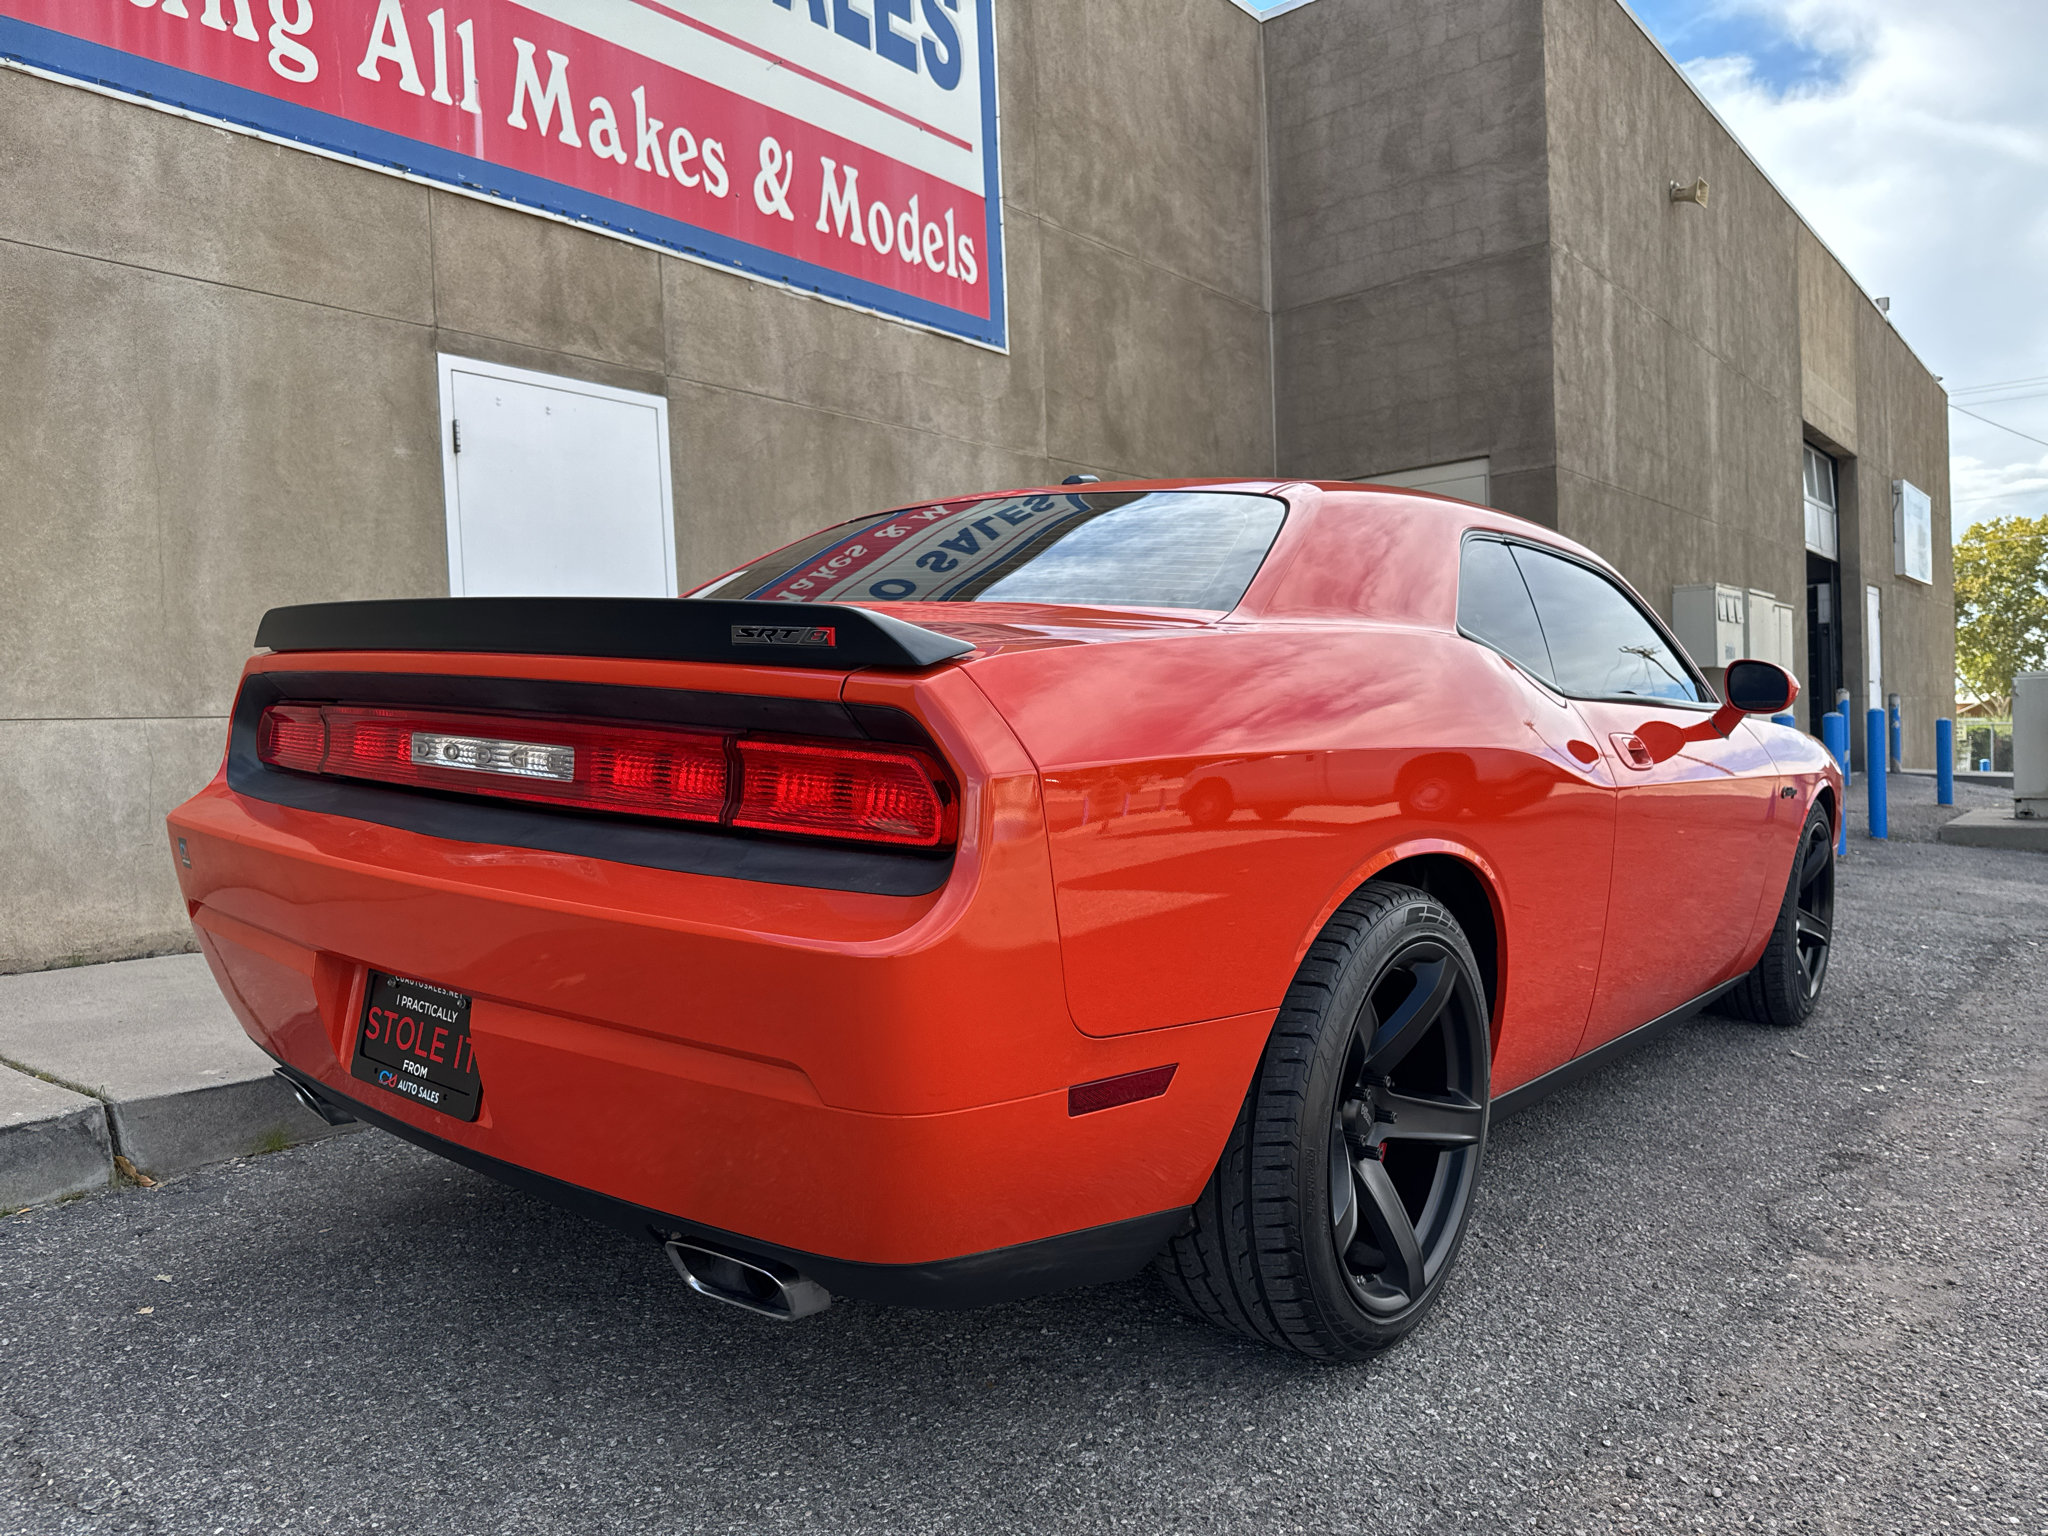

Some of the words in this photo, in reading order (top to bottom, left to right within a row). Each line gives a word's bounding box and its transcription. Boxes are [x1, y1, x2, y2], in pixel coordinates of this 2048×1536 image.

[356, 0, 483, 114] All
[507, 36, 729, 199] Makes
[753, 136, 795, 222] &
[816, 155, 979, 285] Models
[396, 994, 401, 1005] I
[401, 995, 459, 1023] PRACTICALLY
[365, 1006, 448, 1064] STOLE
[402, 1059, 428, 1079] FROM
[397, 1079, 418, 1095] AUTO
[418, 1086, 440, 1104] SALES
